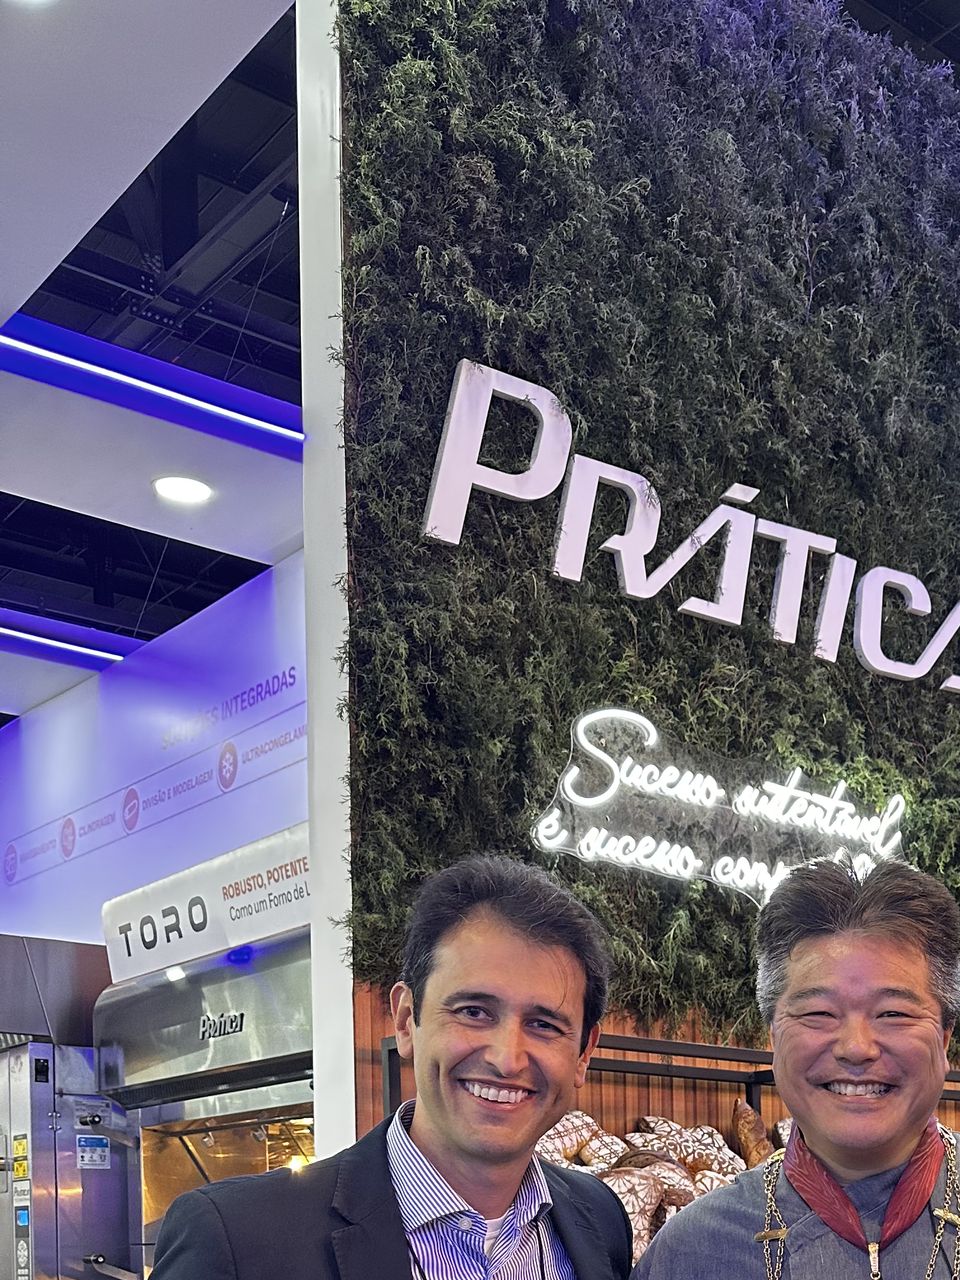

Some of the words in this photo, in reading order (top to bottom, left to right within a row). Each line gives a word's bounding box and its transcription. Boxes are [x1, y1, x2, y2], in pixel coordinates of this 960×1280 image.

[221, 666, 297, 721] INTEGRADAS
[221, 873, 267, 901] ROBUSTO,
[266, 856, 309, 885] POTENTE
[229, 901, 253, 921] Como
[254, 898, 267, 914] um
[267, 888, 293, 910] Forno
[293, 884, 305, 902] de
[118, 895, 208, 957] TORO
